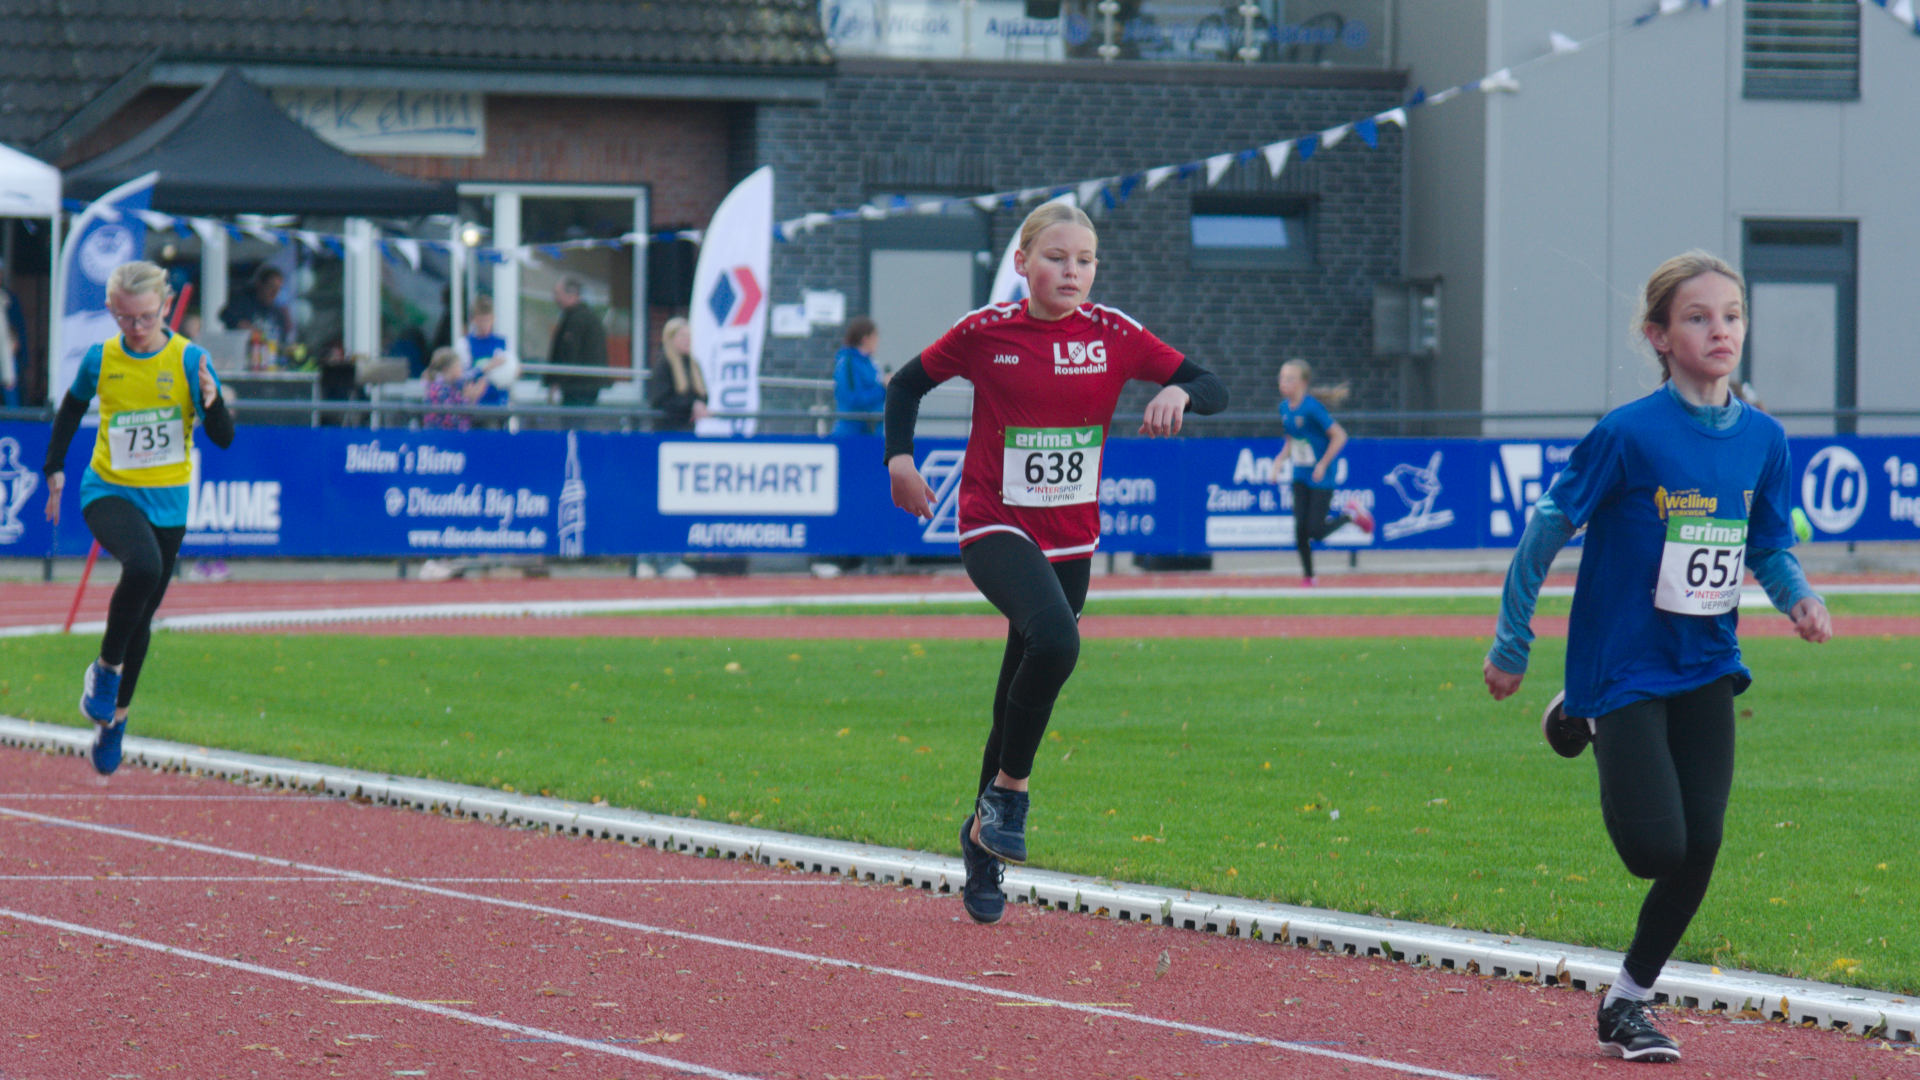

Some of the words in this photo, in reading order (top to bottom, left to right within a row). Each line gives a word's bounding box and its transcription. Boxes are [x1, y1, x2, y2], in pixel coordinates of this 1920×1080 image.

[993, 354, 1019, 365] JAKO
[1054, 363, 1107, 375] Rosendahl
[125, 424, 170, 452] 735
[1015, 431, 1073, 448] erima
[673, 463, 823, 493] TERHART
[1025, 451, 1084, 485] 638
[1884, 456, 1918, 487] 1a
[1034, 484, 1082, 494] INTERSPORT
[1042, 493, 1075, 502] UEPPING
[1206, 484, 1257, 512] Zaun-
[1259, 488, 1277, 512] u.
[406, 483, 482, 517] Discothek
[484, 488, 515, 528] Big
[515, 488, 549, 518] Ben
[1665, 494, 1717, 513] Welling
[688, 523, 806, 548] AUTOMOBILE
[1680, 523, 1741, 542] erima
[1687, 548, 1742, 587] 651
